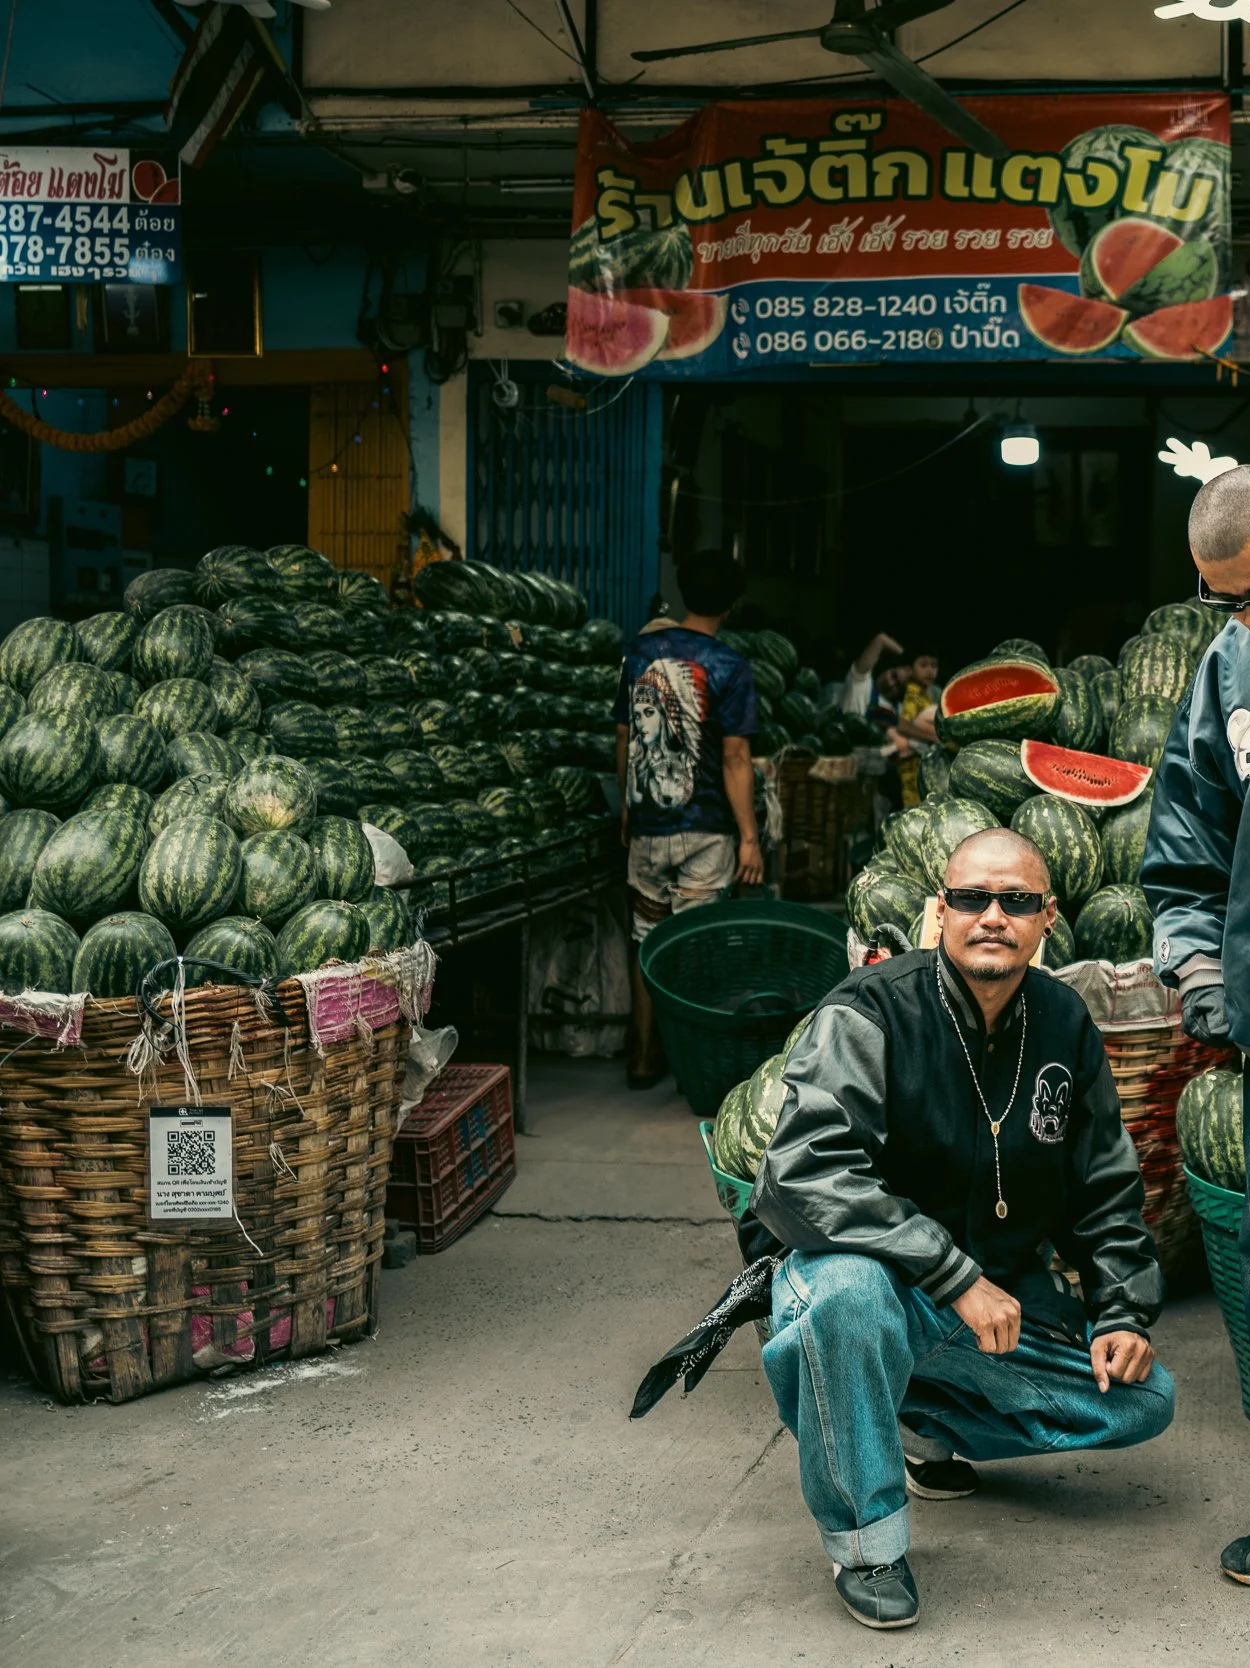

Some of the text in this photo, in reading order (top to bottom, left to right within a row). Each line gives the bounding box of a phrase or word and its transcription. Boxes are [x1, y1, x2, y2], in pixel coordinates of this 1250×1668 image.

[47, 152, 127, 200] แตงโม
[944, 145, 1214, 223] แตงโม
[135, 209, 175, 232] ต้อย
[902, 229, 949, 250] รวย
[954, 228, 1001, 250] รวย
[1007, 227, 1054, 249] รวย
[755, 297, 805, 319] 085
[813, 294, 937, 317] 828-1240
[756, 330, 807, 354] 086
